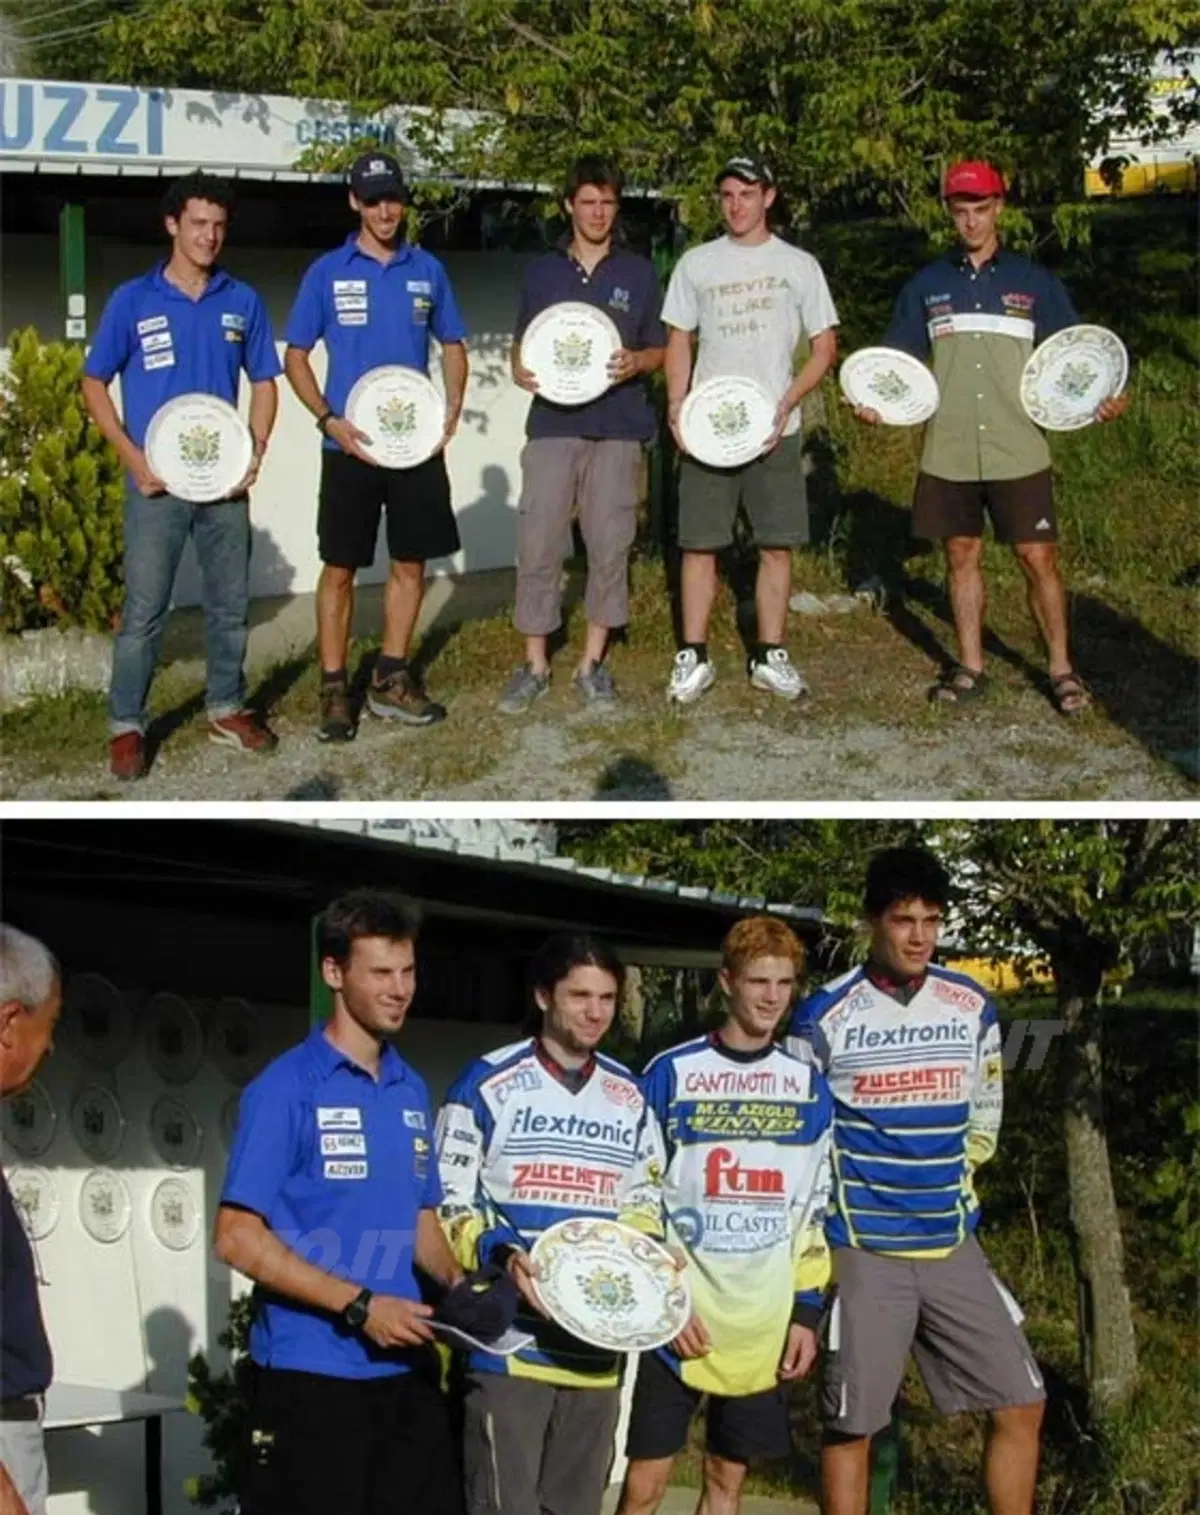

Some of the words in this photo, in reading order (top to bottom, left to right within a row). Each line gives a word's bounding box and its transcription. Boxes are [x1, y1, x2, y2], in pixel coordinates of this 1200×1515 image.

[844, 1017, 970, 1051] Flextronic
[853, 1066, 963, 1095] ZUCCHETTI
[512, 1106, 635, 1146] Flextronic
[706, 1147, 785, 1197] ftm
